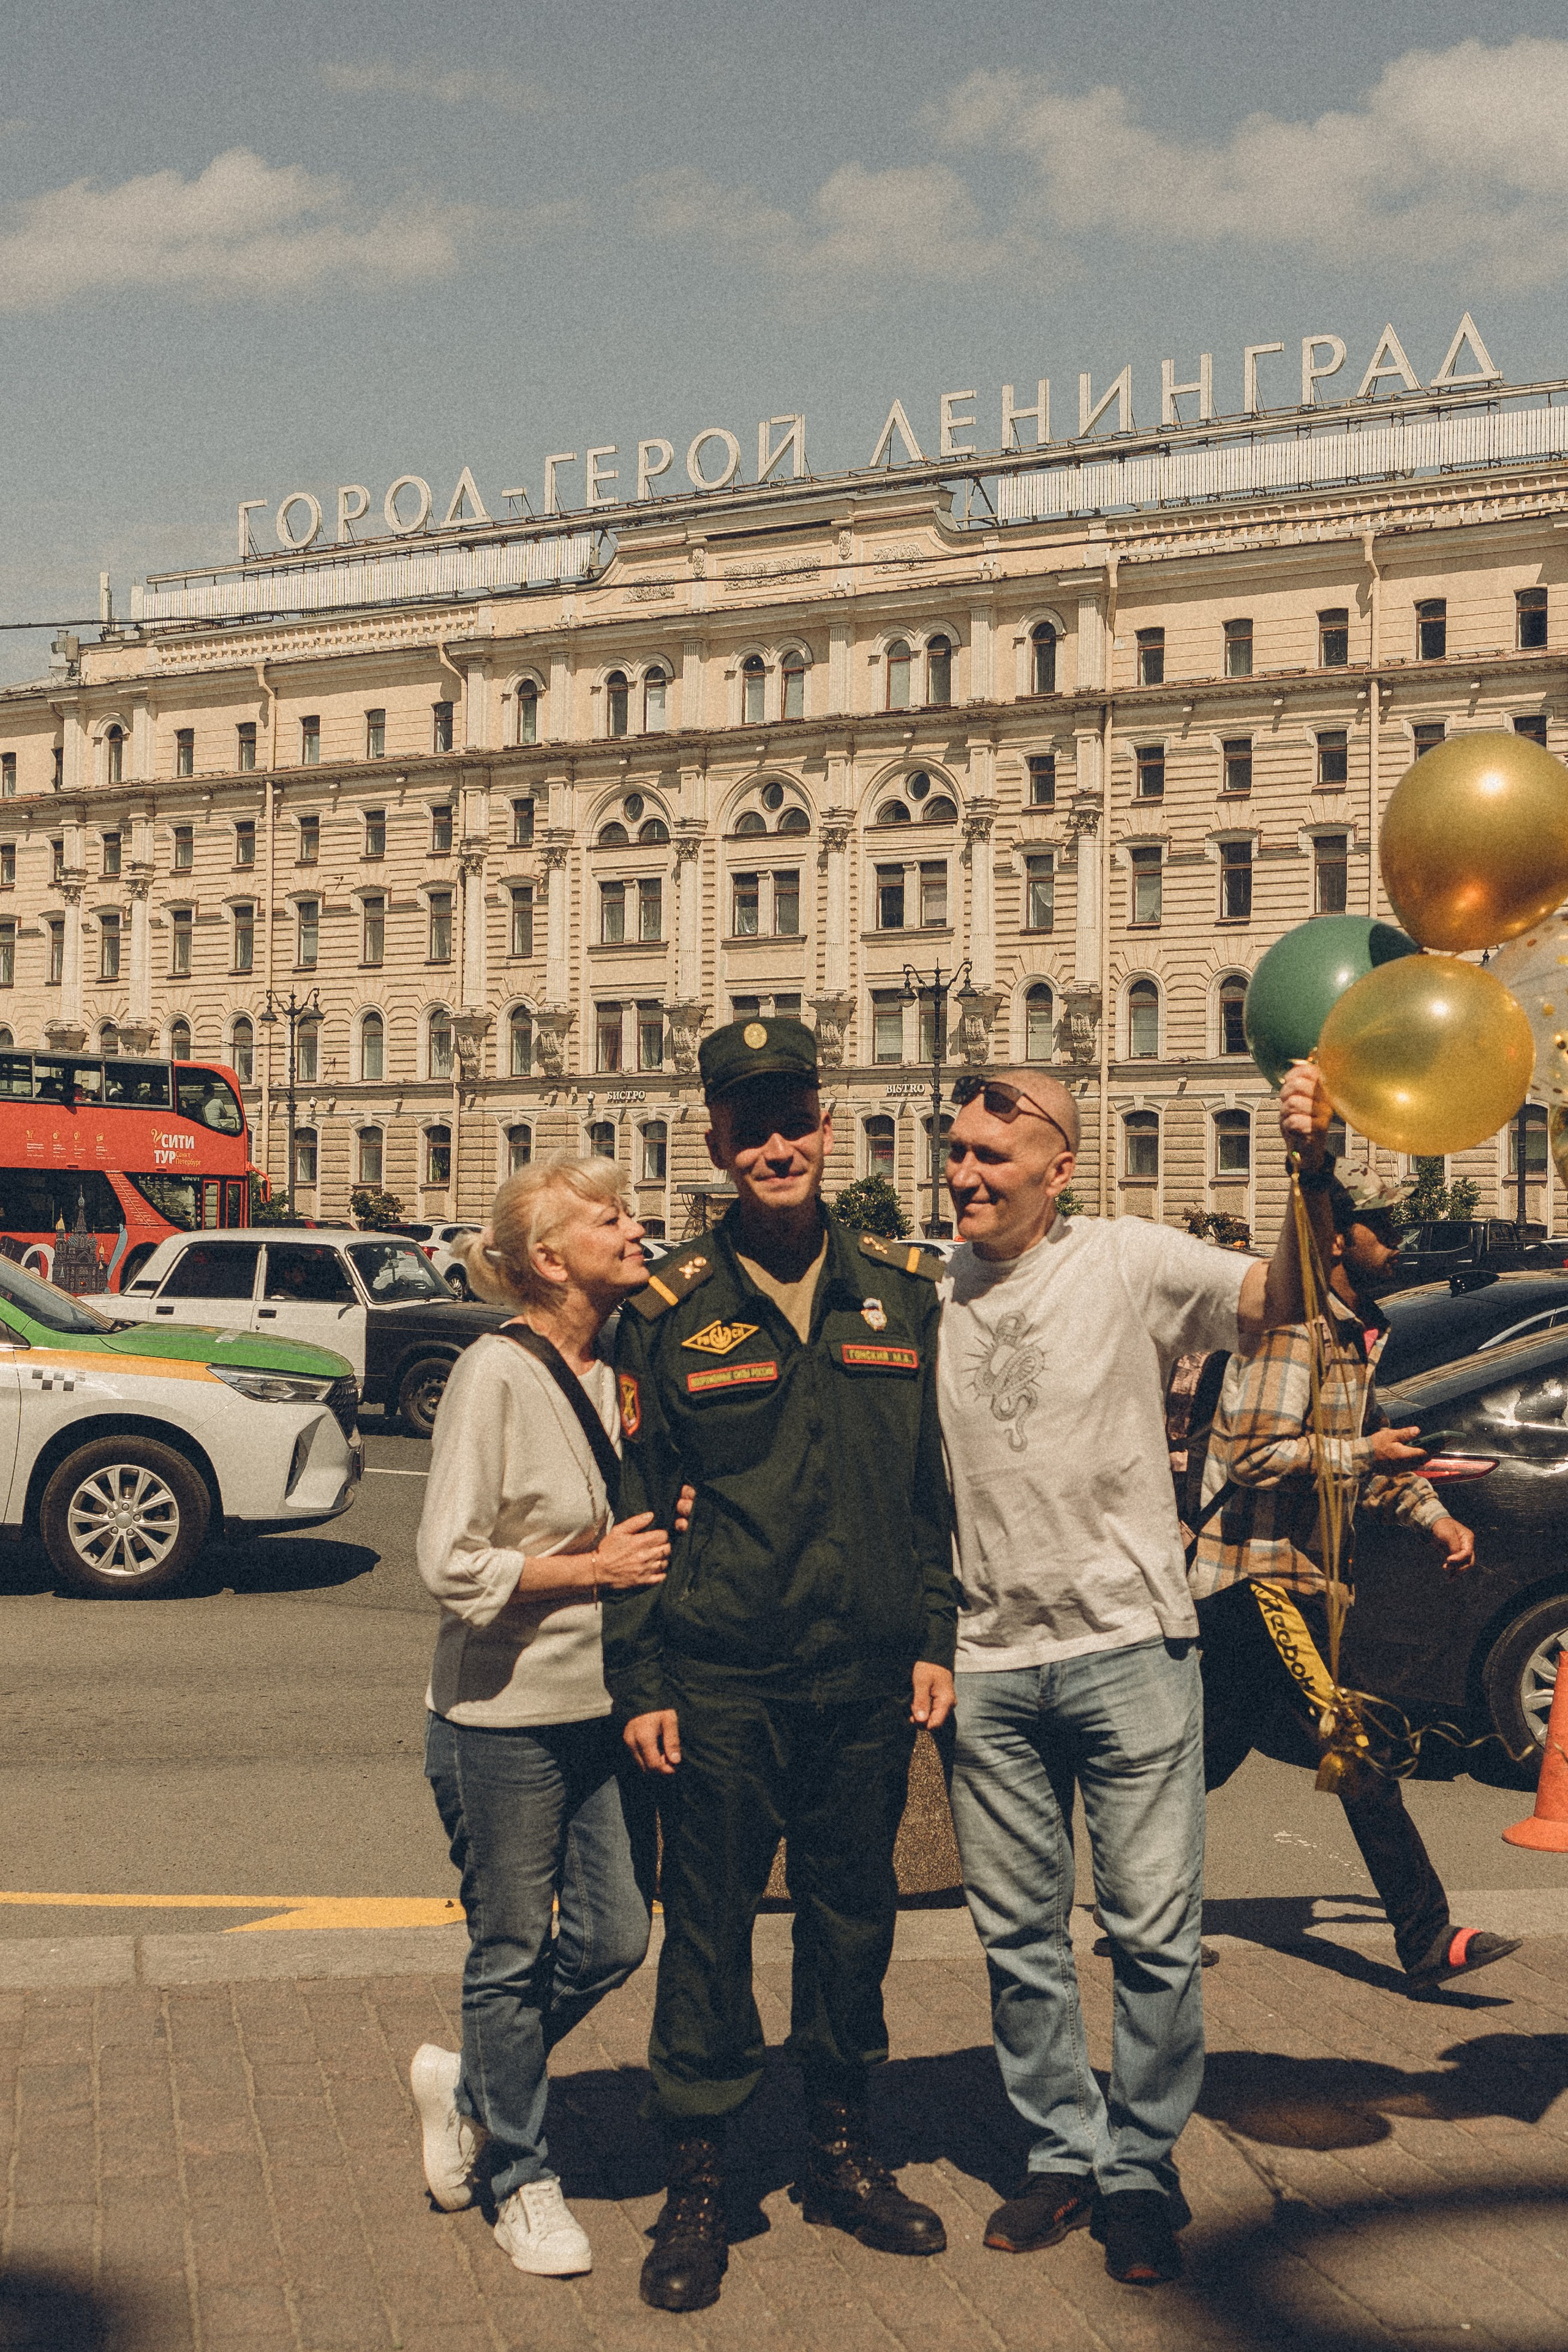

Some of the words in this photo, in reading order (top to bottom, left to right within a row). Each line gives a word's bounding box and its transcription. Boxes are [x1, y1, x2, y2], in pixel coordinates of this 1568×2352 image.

[238, 413, 805, 557] ГОРОД-ГЕРОЙ
[869, 311, 1504, 467] ЛЕНИНГРАД
[607, 1090, 646, 1100] БИСТРО
[886, 1084, 925, 1093] BISTRO
[161, 1134, 195, 1149] СИТИ
[154, 1150, 176, 1164] ТУР
[1256, 1597, 1316, 1691] Reebok
